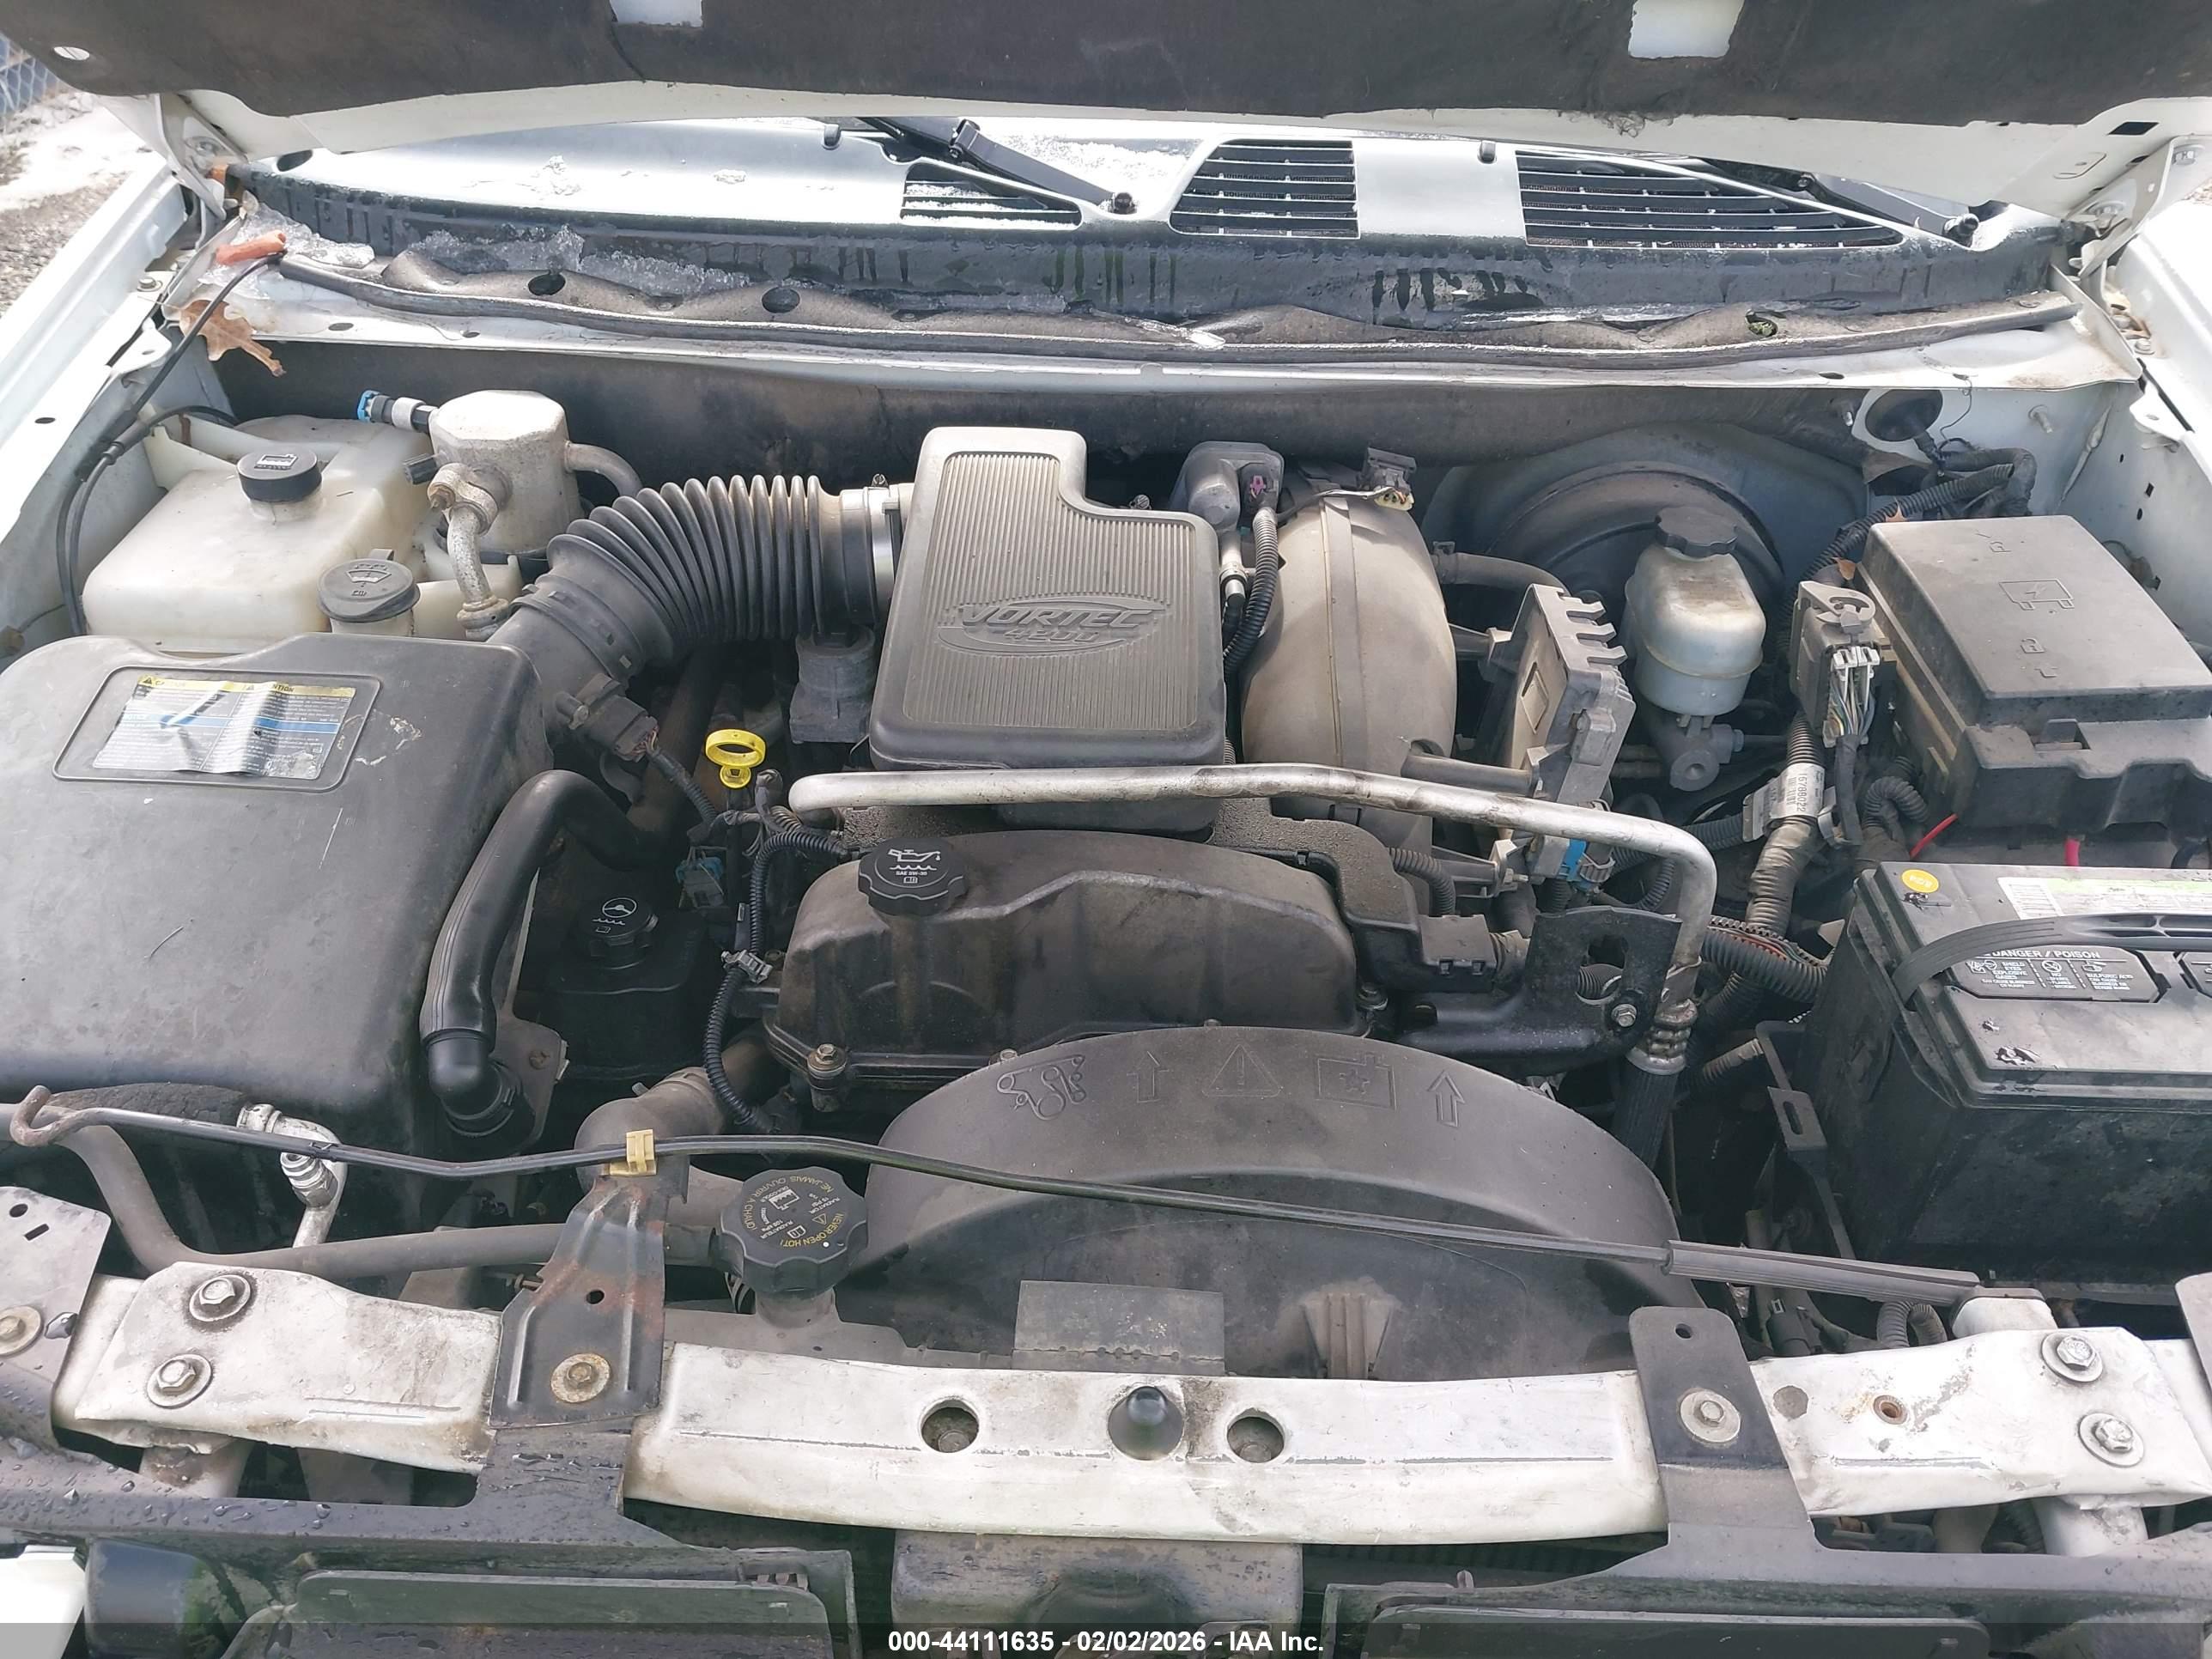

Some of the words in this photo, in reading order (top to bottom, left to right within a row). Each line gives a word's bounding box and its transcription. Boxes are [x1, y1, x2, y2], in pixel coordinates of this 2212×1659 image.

[959, 605, 1153, 629] VORTEC
[1003, 628, 1100, 643] 4200
[754, 1177, 787, 1197] OUVRIR
[808, 1197, 841, 1214] RADIATOR
[826, 1212, 845, 1235] NEVER
[803, 1231, 827, 1245] OPEN
